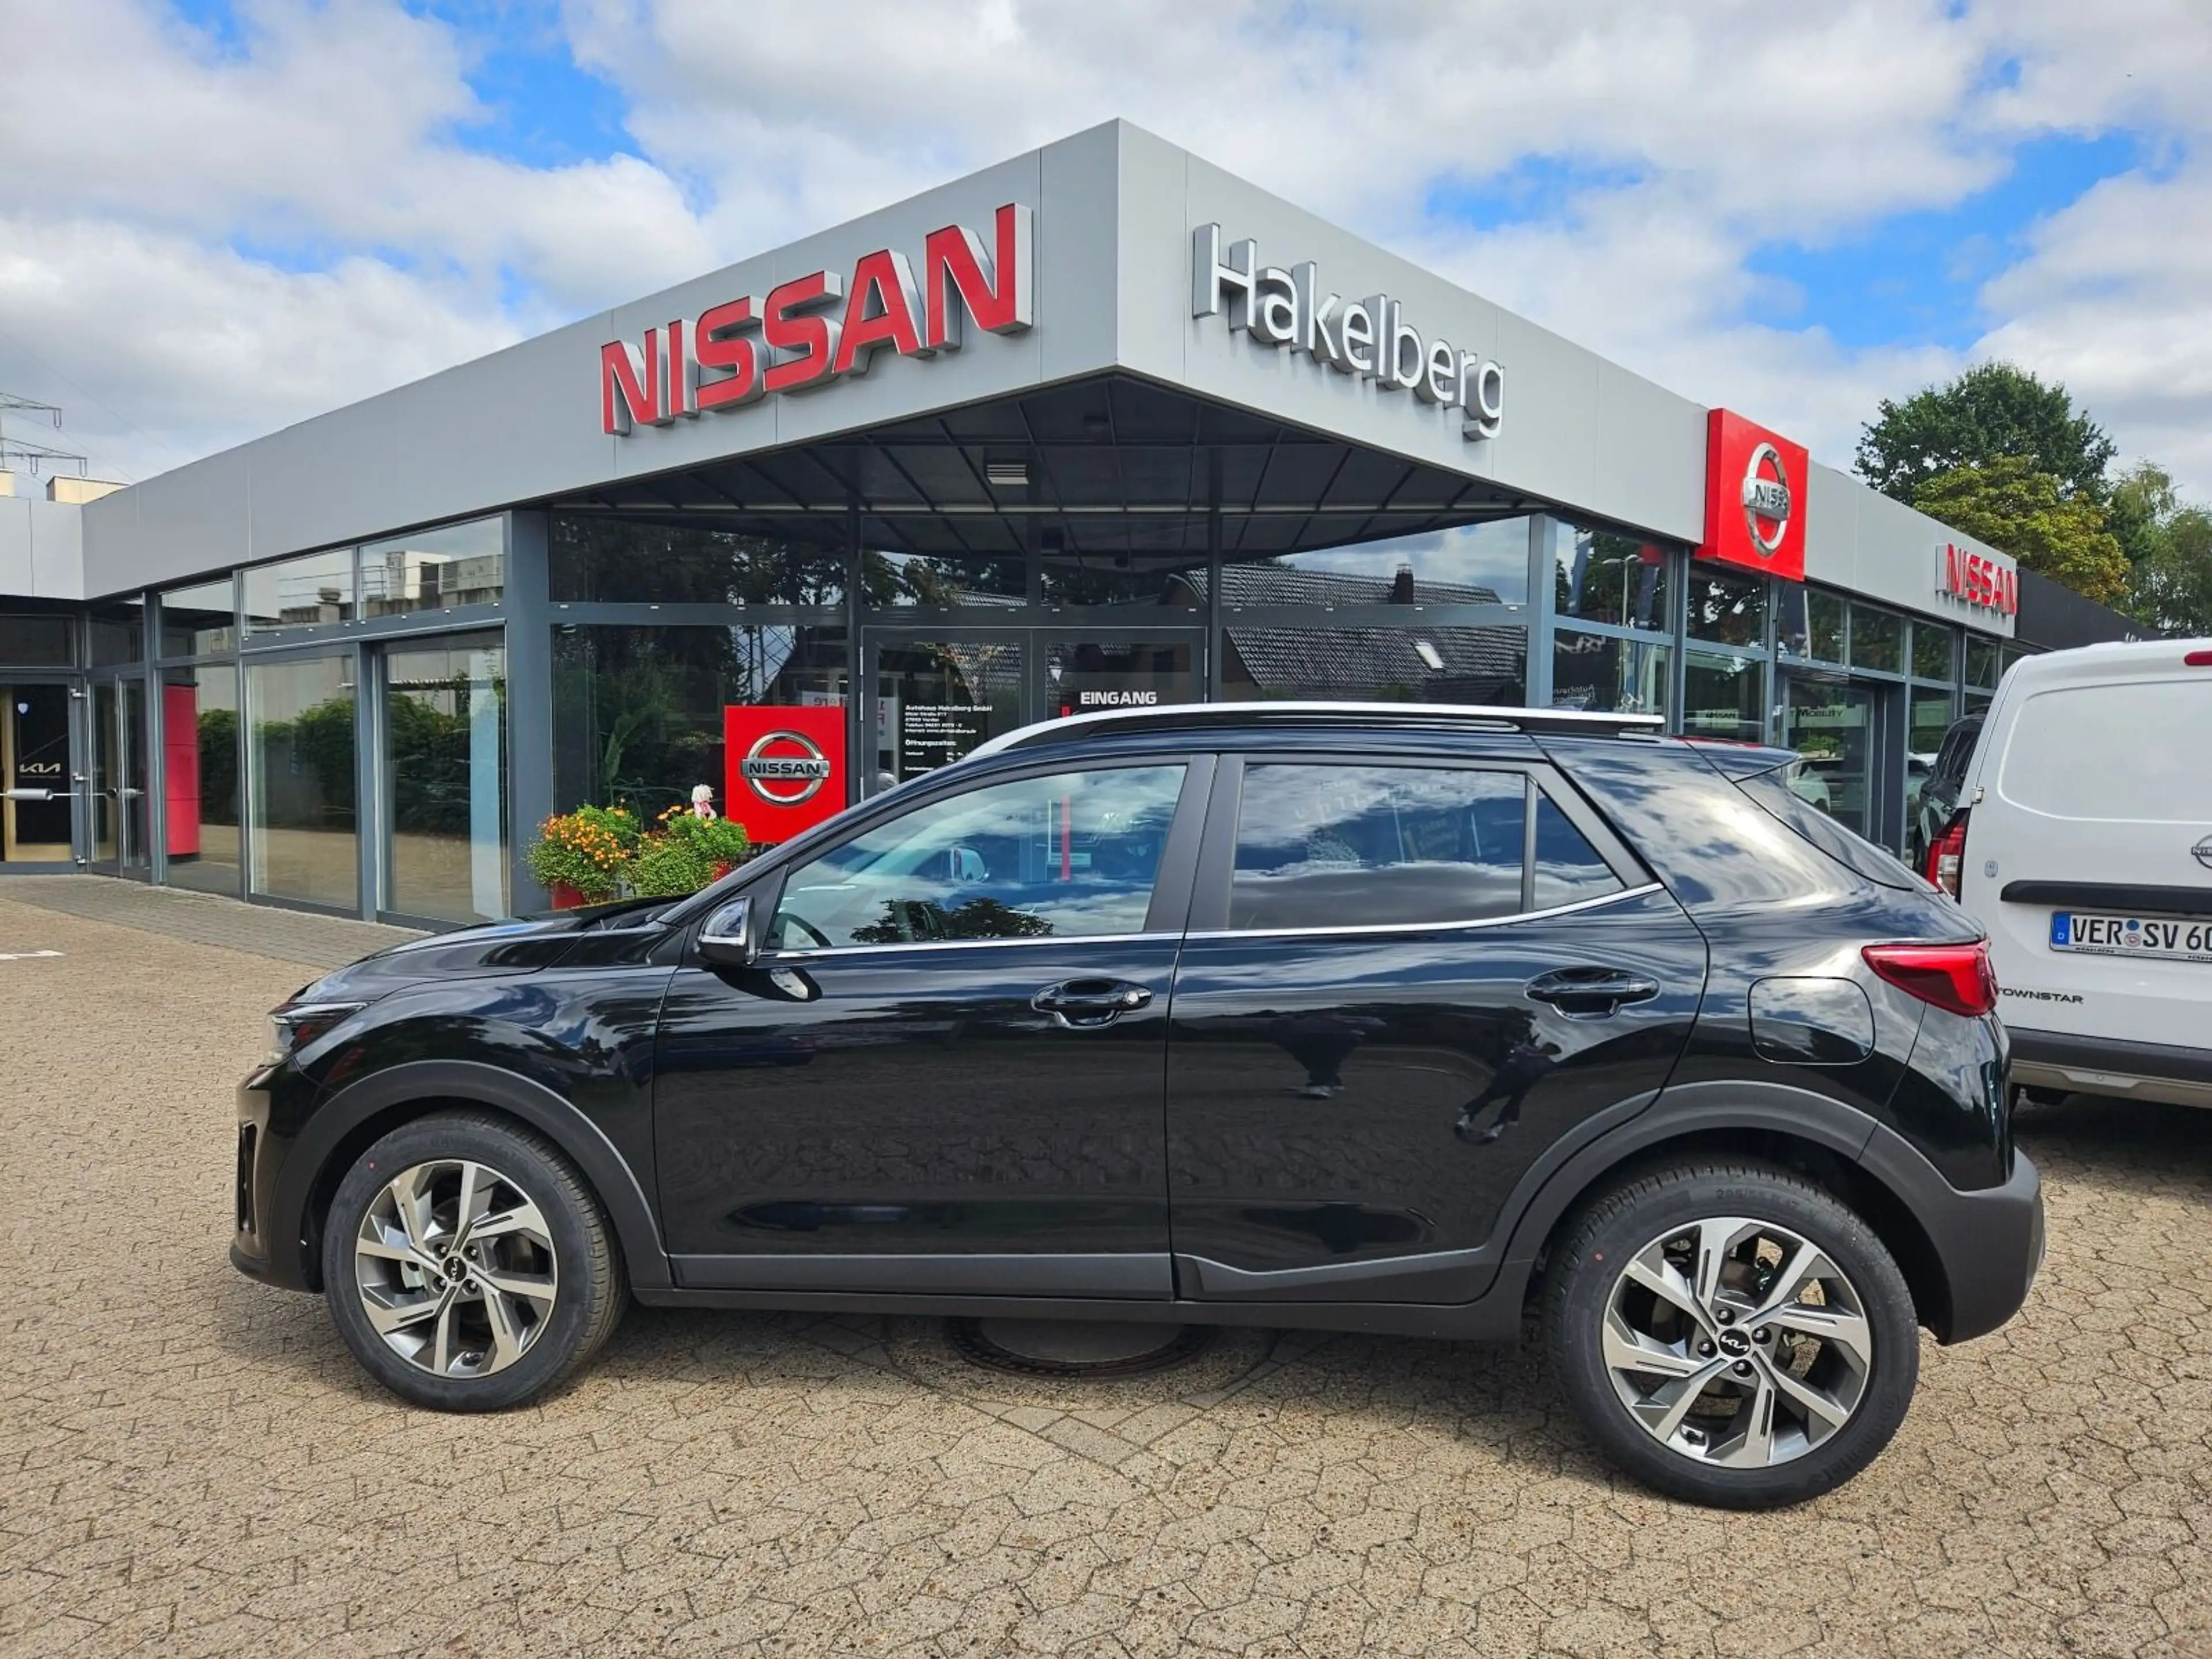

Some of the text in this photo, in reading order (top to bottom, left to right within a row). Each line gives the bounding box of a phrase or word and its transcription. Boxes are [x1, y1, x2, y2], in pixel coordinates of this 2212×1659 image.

[601, 203, 1031, 435] NISSAN
[1192, 222, 1505, 441] Hakelberg
[1946, 543, 2017, 616] NISSAN
[1081, 691, 1157, 704] EINGANG
[19, 763, 60, 773] KIA
[749, 763, 820, 774] NISSAN
[2073, 918, 2123, 945] VER
[2143, 923, 2179, 949] SV
[1721, 1335, 1750, 1352] KIA
